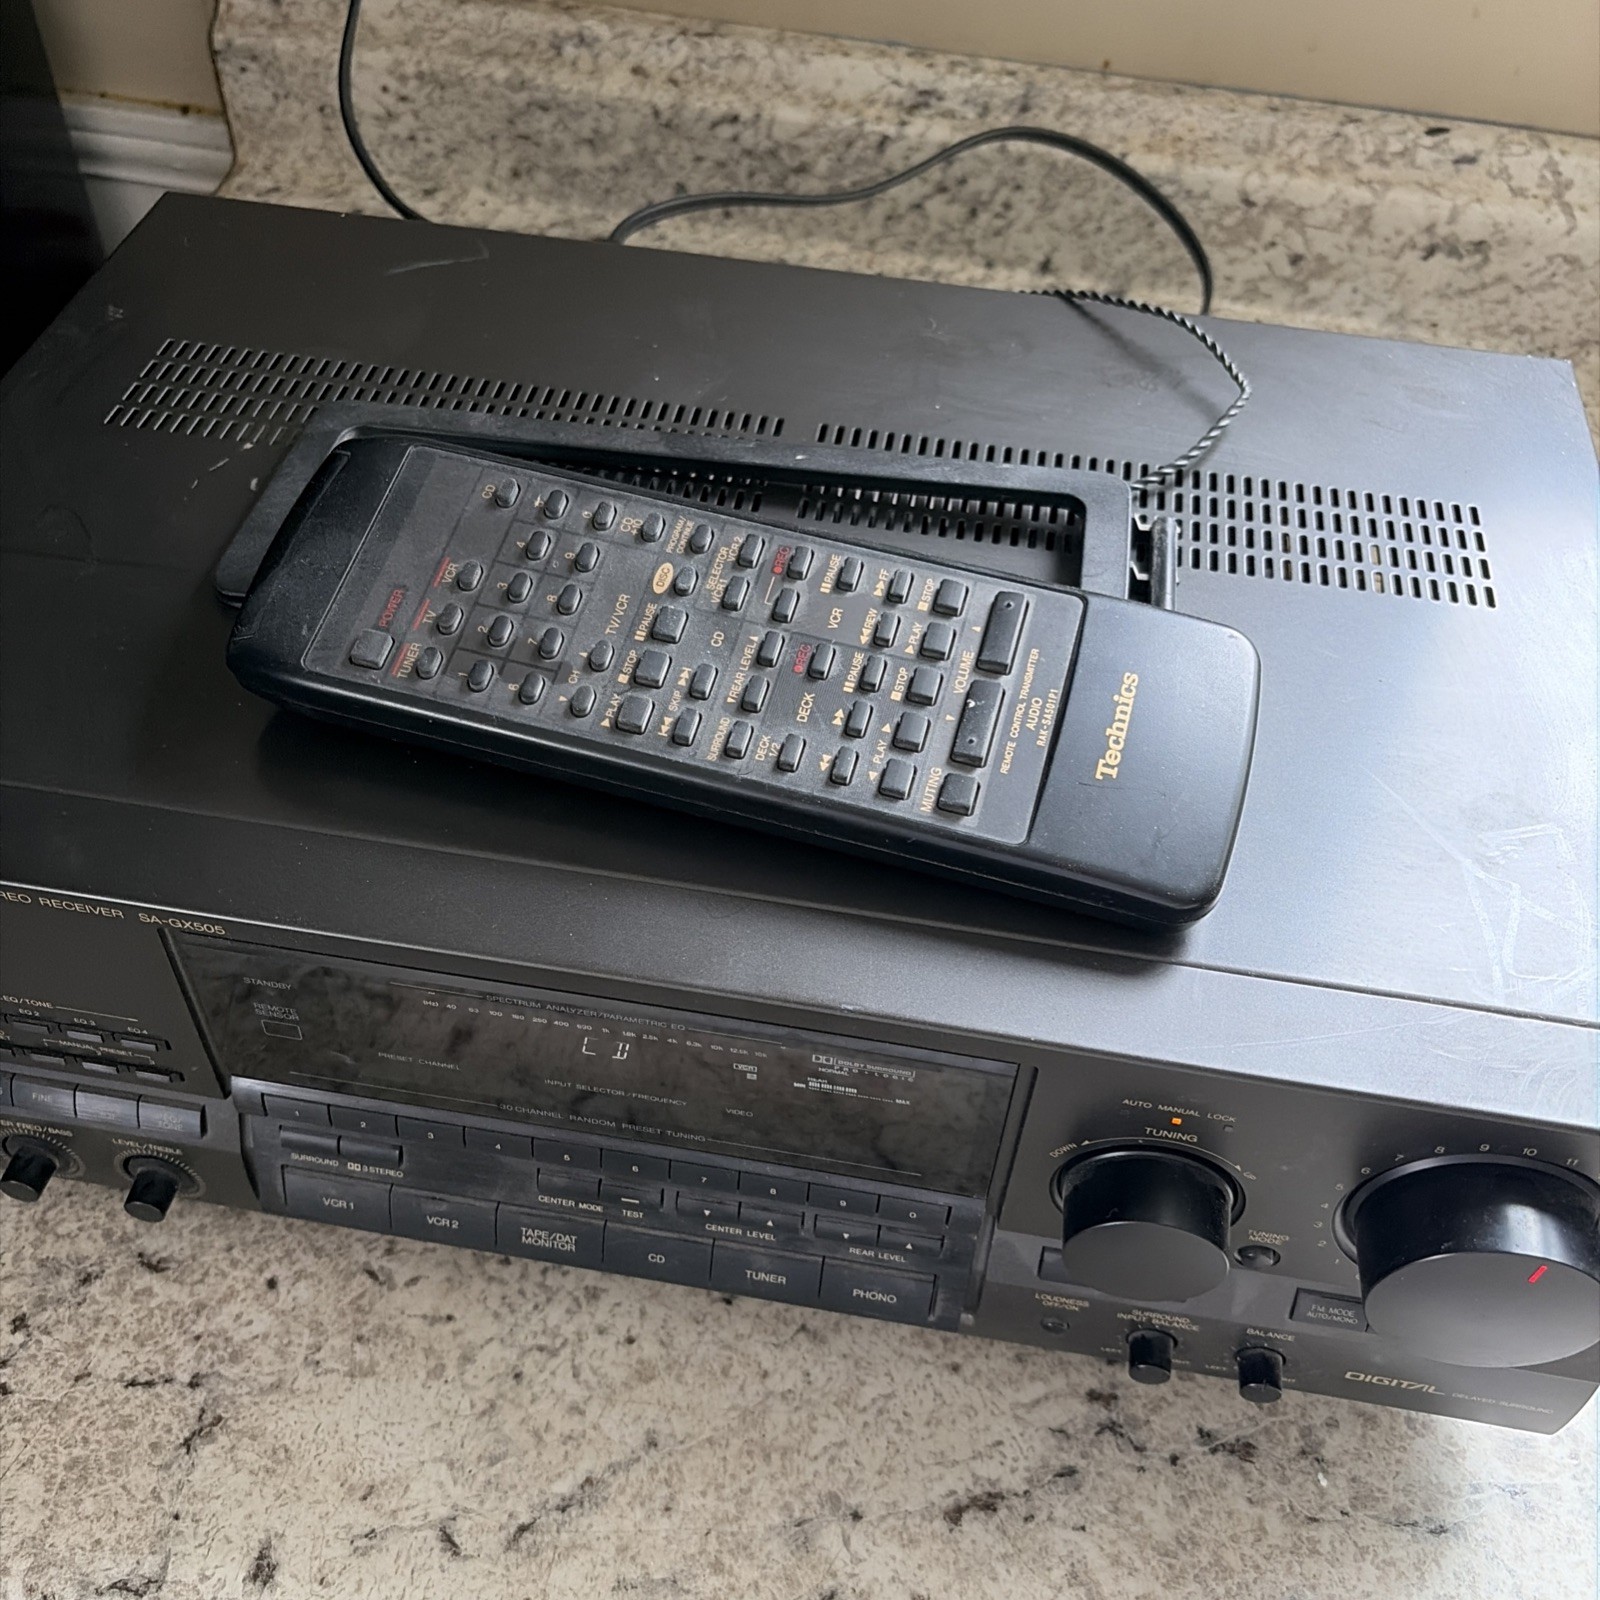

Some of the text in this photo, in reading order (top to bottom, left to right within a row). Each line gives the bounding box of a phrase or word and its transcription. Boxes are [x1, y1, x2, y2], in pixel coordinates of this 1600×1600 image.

[482, 484, 496, 499] CD
[620, 517, 634, 532] CD
[630, 519, 643, 535] +10
[666, 515, 687, 554] PROGRAM/
[676, 520, 695, 554] CONTINUE
[516, 541, 526, 549] 4
[727, 544, 740, 562] VCR
[564, 552, 576, 560] 9
[775, 546, 790, 567] REC
[442, 563, 460, 583] VCR
[706, 546, 729, 590] SELECTOR
[824, 554, 841, 582] PAUSE
[879, 569, 890, 581] FF
[497, 582, 508, 590] 3
[656, 567, 670, 588] DISC
[547, 594, 558, 603] 8
[922, 579, 935, 602] STOP
[379, 589, 405, 629] POWER
[422, 610, 437, 624] TV
[605, 594, 631, 635] TV/VCR
[639, 602, 658, 632] PAUSE
[827, 608, 844, 629] VCR
[865, 608, 878, 630] REW
[477, 626, 488, 634] 2
[909, 622, 923, 645] PLAY
[527, 638, 538, 646] 7
[711, 631, 724, 647] CD
[396, 642, 422, 678] TUNER
[623, 650, 638, 674] STOP
[798, 644, 812, 664] REC
[732, 643, 757, 699] REAR LEVEL
[847, 652, 864, 681] PAUSE
[953, 650, 975, 694] VOLUME
[568, 670, 580, 684] CH
[894, 667, 909, 692] STOP
[508, 683, 519, 691] 6
[606, 693, 622, 717] PLAY
[669, 690, 681, 711] SKIP
[797, 692, 815, 723] DECK
[1000, 648, 1040, 775] REMOTE CONTROL TRANSMITTER
[1026, 697, 1043, 731] AUDIO
[1095, 672, 1139, 780] Technics
[707, 717, 730, 761] SURROUND
[756, 735, 771, 761] DECK
[769, 742, 780, 757] 1/2
[873, 739, 887, 764] PLAY
[919, 767, 942, 812] MUTING
[39, 897, 125, 919] RECEIVER
[138, 912, 226, 935] SA-GX505
[242, 976, 292, 991] STANDBY
[19, 1008, 32, 1016] EQ
[253, 1002, 297, 1014] REMOTE
[254, 1008, 300, 1021] SENSOR
[486, 994, 542, 1009] SPECTRUM
[670, 1022, 686, 1031] EQ
[58, 1040, 94, 1051] MANUAL
[99, 1047, 134, 1057] PRESET
[378, 1052, 461, 1071] PRESET CHANNEL
[544, 1078, 572, 1089] INPUT
[725, 1107, 754, 1118] VIDEO
[1122, 1098, 1237, 1124] AUTO MANUAL LOCK
[514, 1106, 565, 1120] CHANNEL
[569, 1114, 616, 1128] RANDOM
[621, 1122, 662, 1135] PRESET
[665, 1129, 706, 1142] TUNING
[1144, 1126, 1198, 1143] TUNING
[1049, 1142, 1077, 1159] DOWN
[1434, 1146, 1445, 1154] 8
[1479, 1143, 1490, 1152] 9
[1523, 1147, 1538, 1157] 10
[291, 1152, 339, 1167] SURROUND
[369, 1166, 404, 1178] STEREO
[1361, 1167, 1371, 1175] 6
[322, 1196, 347, 1210] VCR
[537, 1194, 604, 1213] CENTER MODE
[426, 1215, 459, 1229] VCR 2
[621, 1209, 644, 1219] TEST
[705, 1223, 777, 1242] CENTER LEVEL
[1313, 1221, 1323, 1229] 3
[521, 1227, 578, 1244] TAPE/DAT
[521, 1236, 576, 1252] MONITOR
[1247, 1229, 1290, 1242] TUNING
[1248, 1235, 1283, 1246] MODE
[1317, 1240, 1327, 1248] 2
[648, 1253, 666, 1264] CD
[849, 1247, 907, 1263] REAR LEVEL
[745, 1269, 787, 1286] TUNER
[853, 1288, 897, 1304] PHONO
[1035, 1293, 1090, 1308] LOUDNESS
[1042, 1300, 1080, 1312] OFF/ON
[1311, 1304, 1356, 1318] FM MODE
[1117, 1312, 1200, 1332] INPUT BALANCE
[1131, 1309, 1191, 1325] SURROUND
[1306, 1311, 1358, 1325] AUTO/MONO
[1246, 1327, 1296, 1342] BALANCE
[1344, 1371, 1445, 1396] DIGITAL
